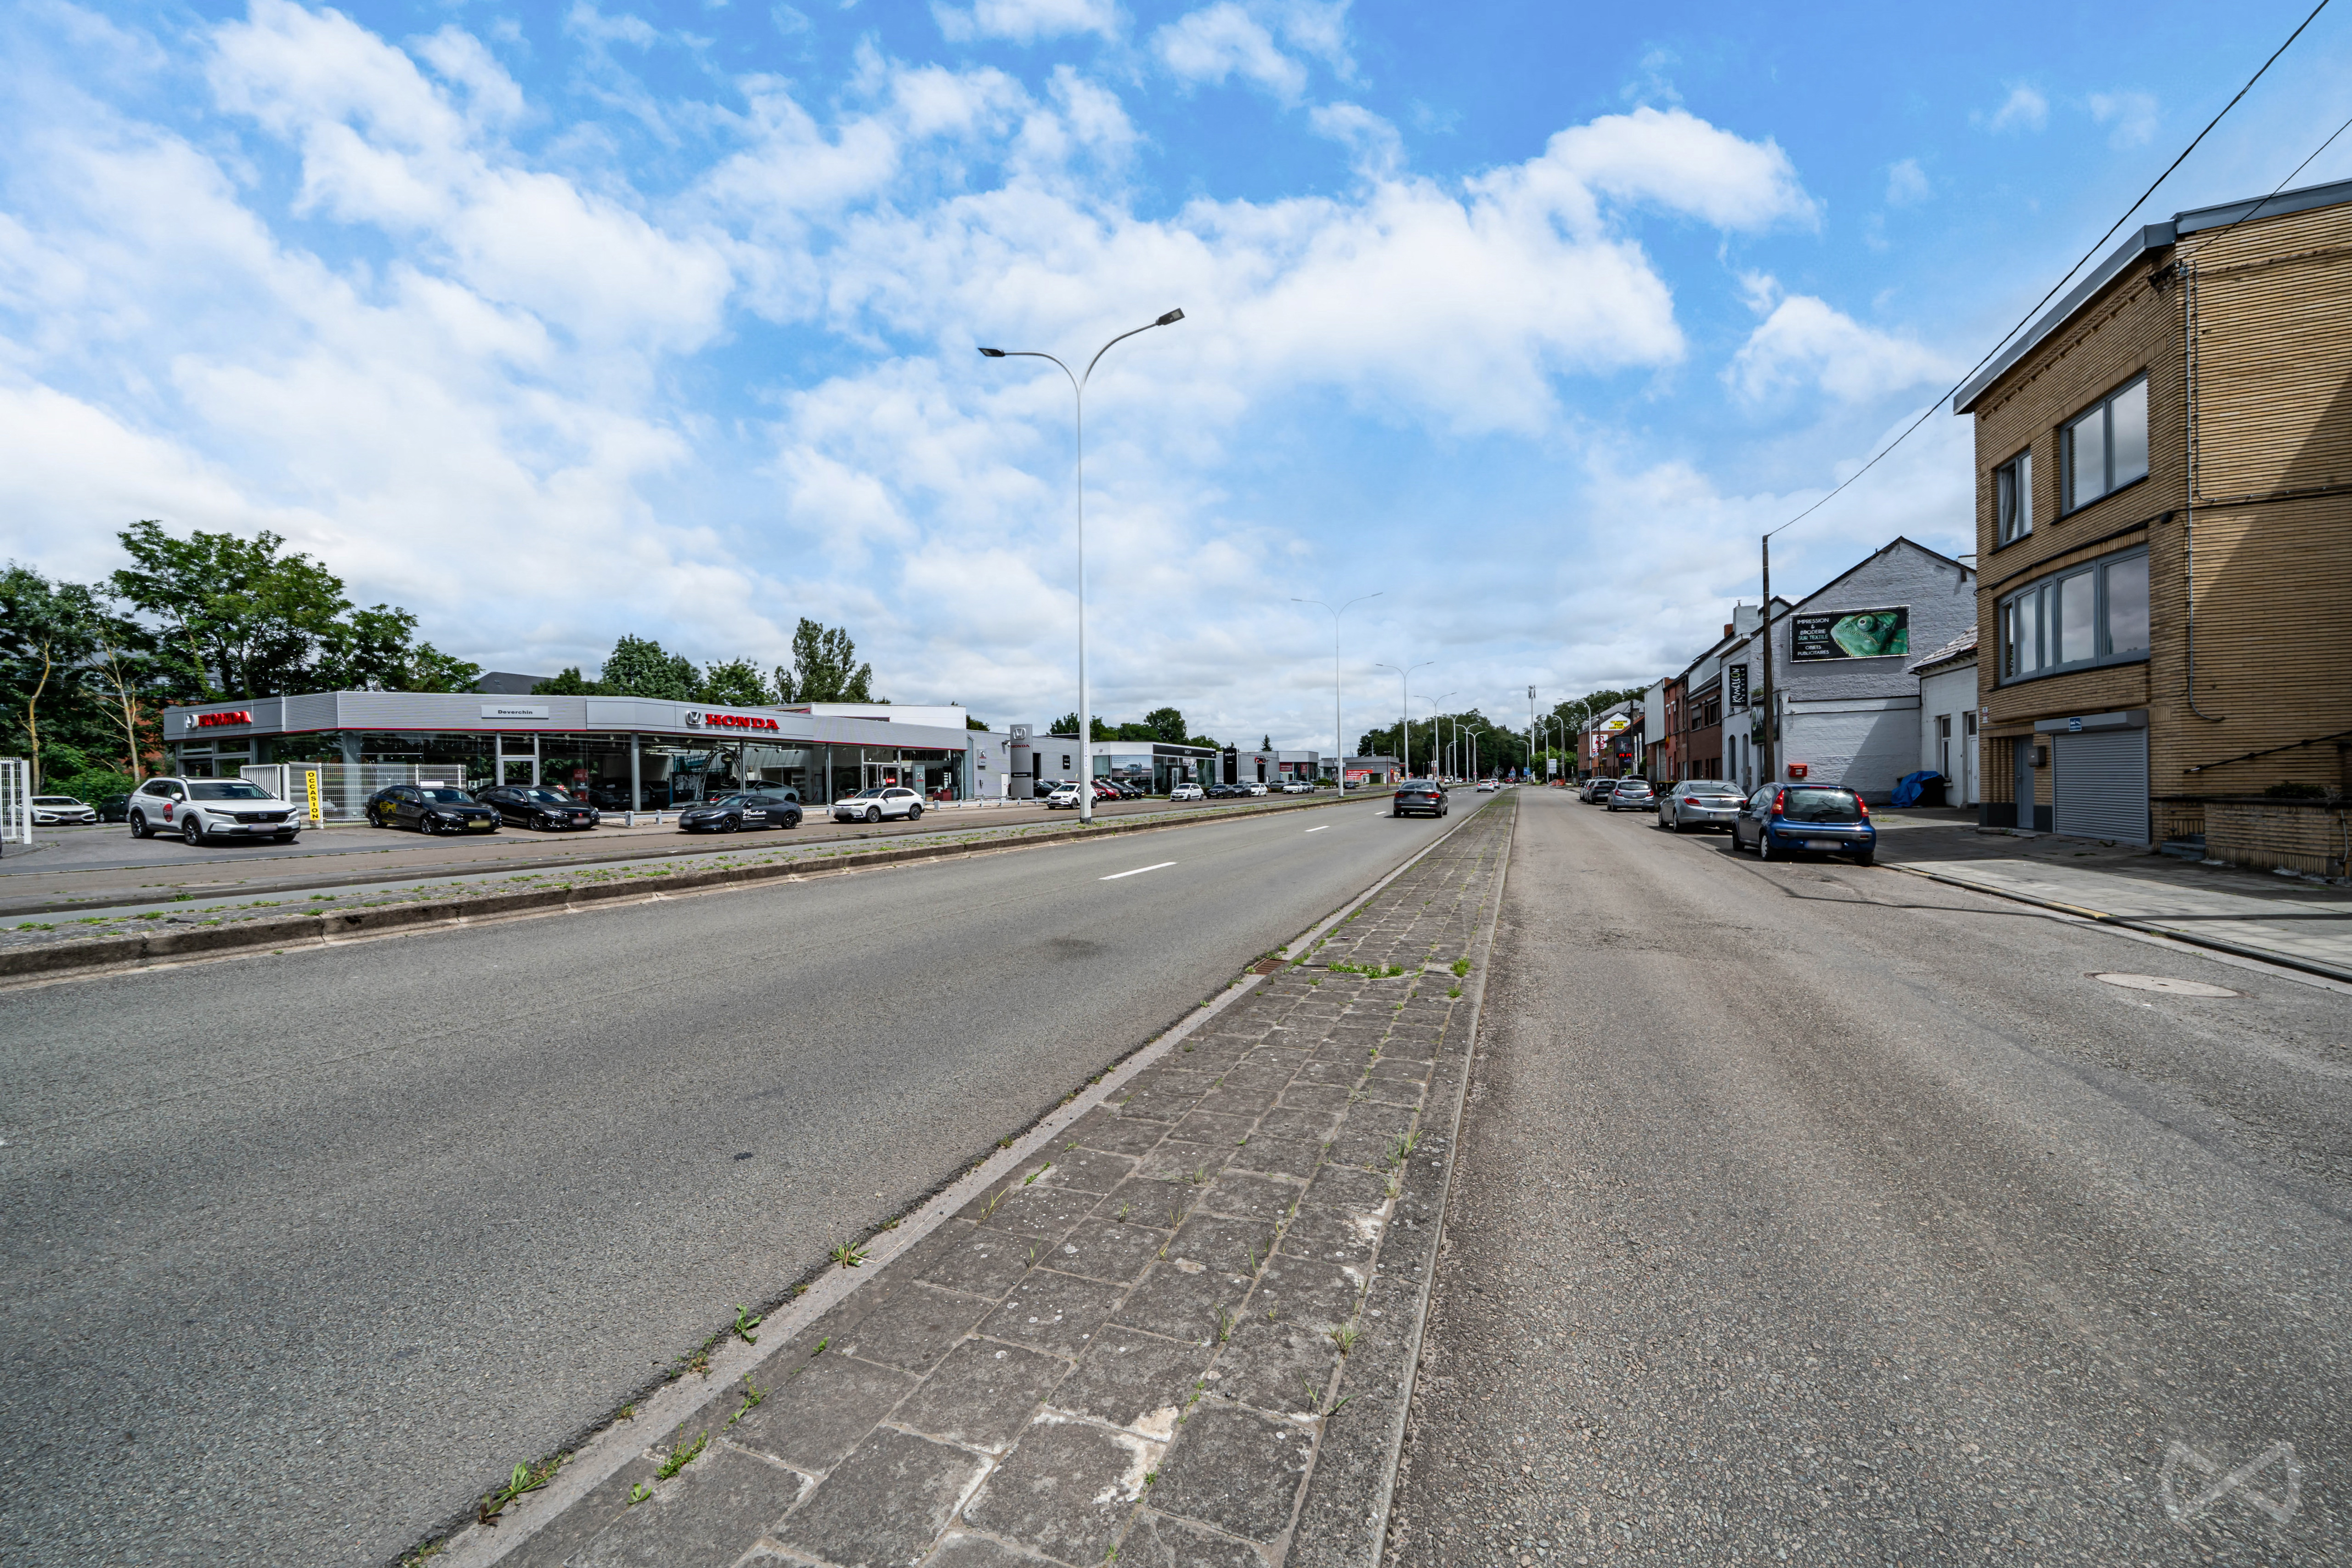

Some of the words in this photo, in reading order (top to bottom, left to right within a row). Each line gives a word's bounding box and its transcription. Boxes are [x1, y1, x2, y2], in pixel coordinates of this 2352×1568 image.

[198, 711, 252, 727] HONDA
[705, 713, 780, 729] HONDA
[308, 772, 319, 819] OCCASION
